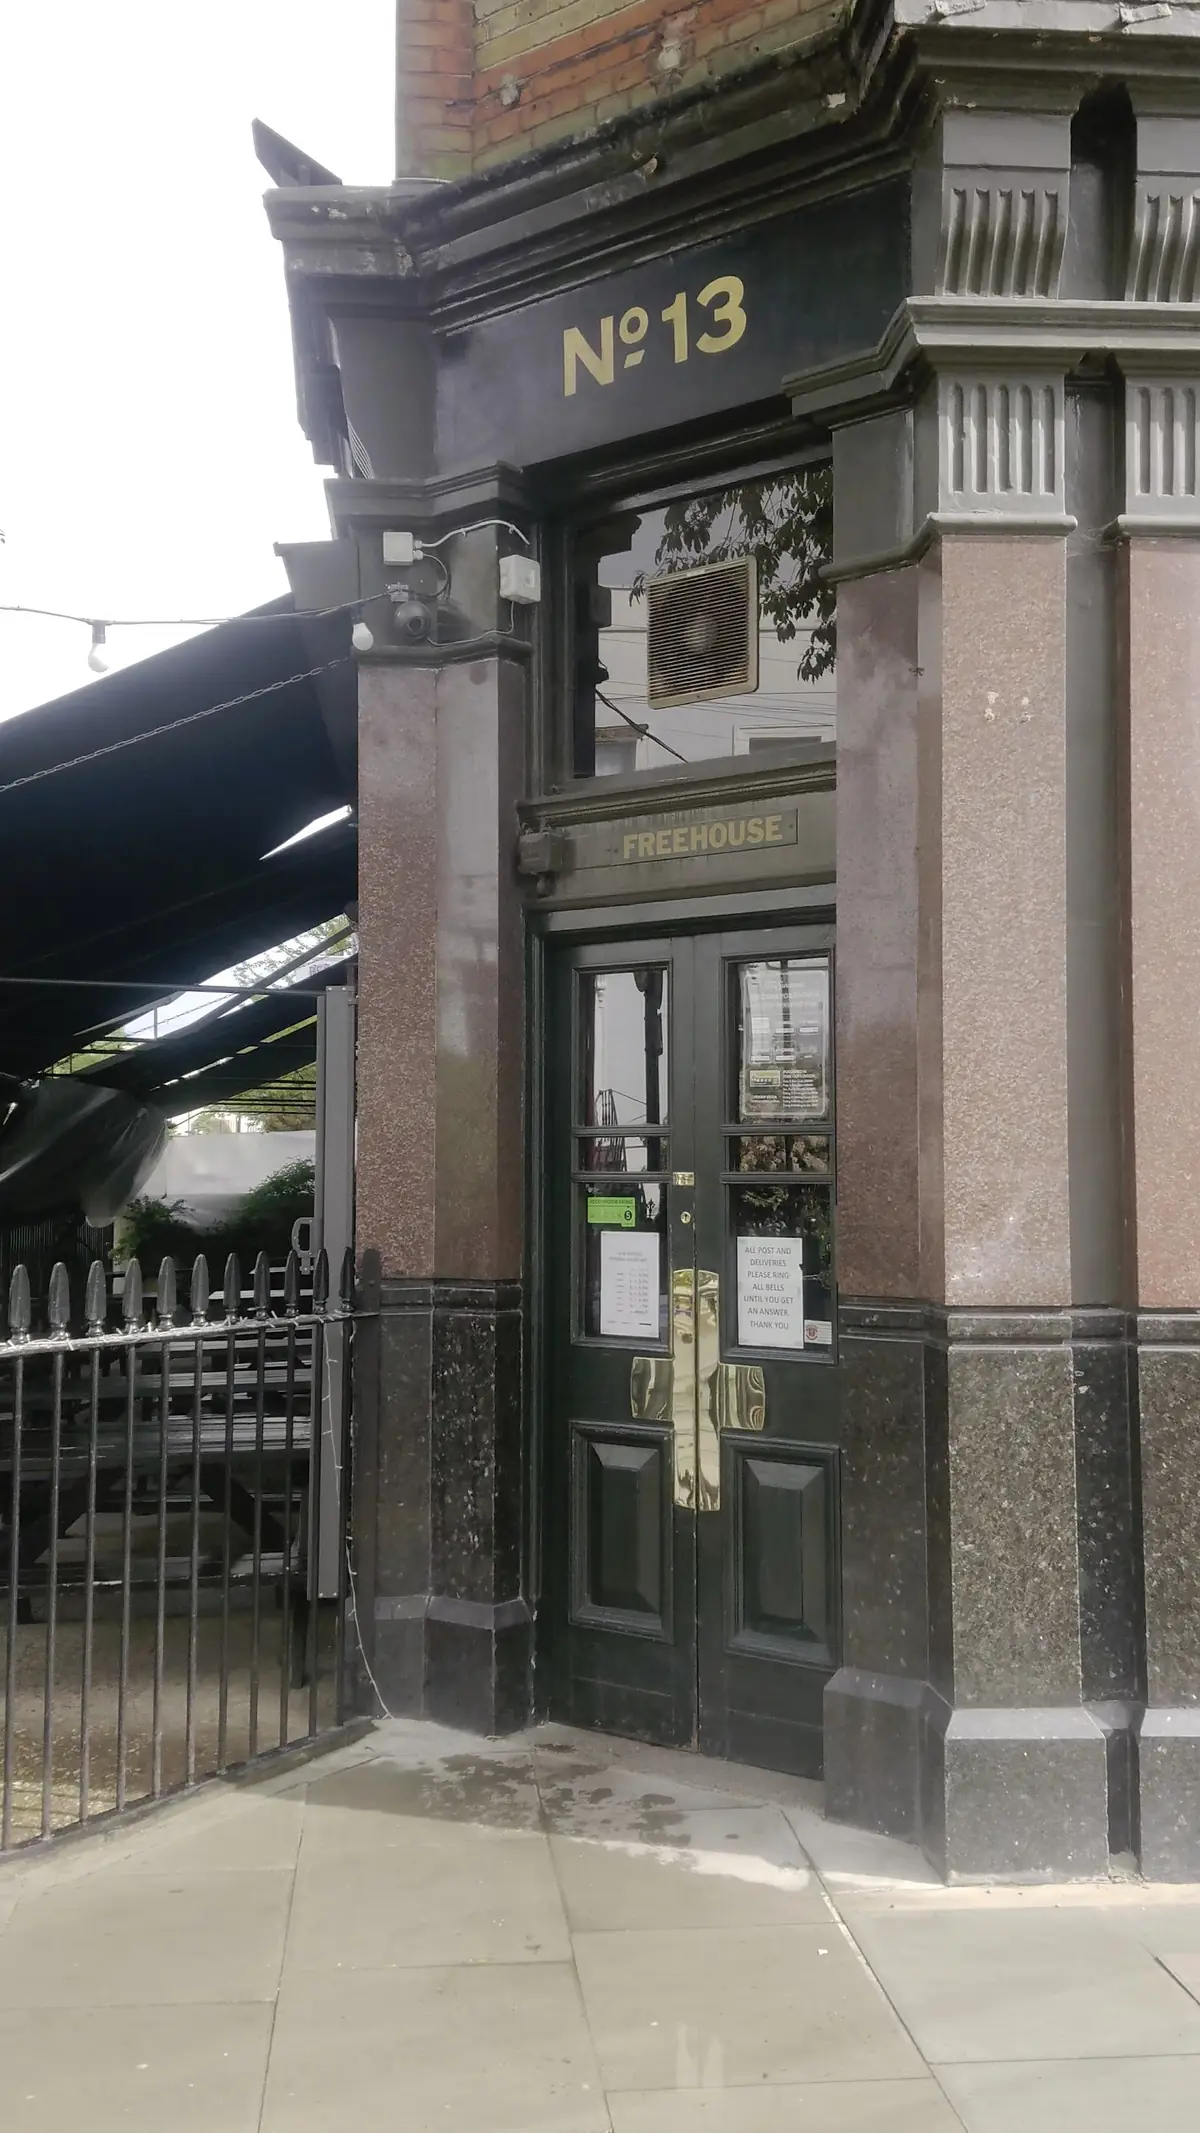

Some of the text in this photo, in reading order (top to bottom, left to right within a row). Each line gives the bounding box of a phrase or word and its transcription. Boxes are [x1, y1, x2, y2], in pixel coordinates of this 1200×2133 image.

[661, 275, 747, 364] 13
[623, 815, 782, 859] FREEHOUSE
[744, 1246, 792, 1255] ALL POST AND
[749, 1258, 787, 1267] DELIVERIES
[747, 1270, 790, 1280] PLEASE RING
[752, 1283, 785, 1292] ALL BELLS
[743, 1295, 794, 1304] UNTIL YOU GET
[747, 1307, 758, 1315] AN
[749, 1320, 789, 1330] THANK YOU
